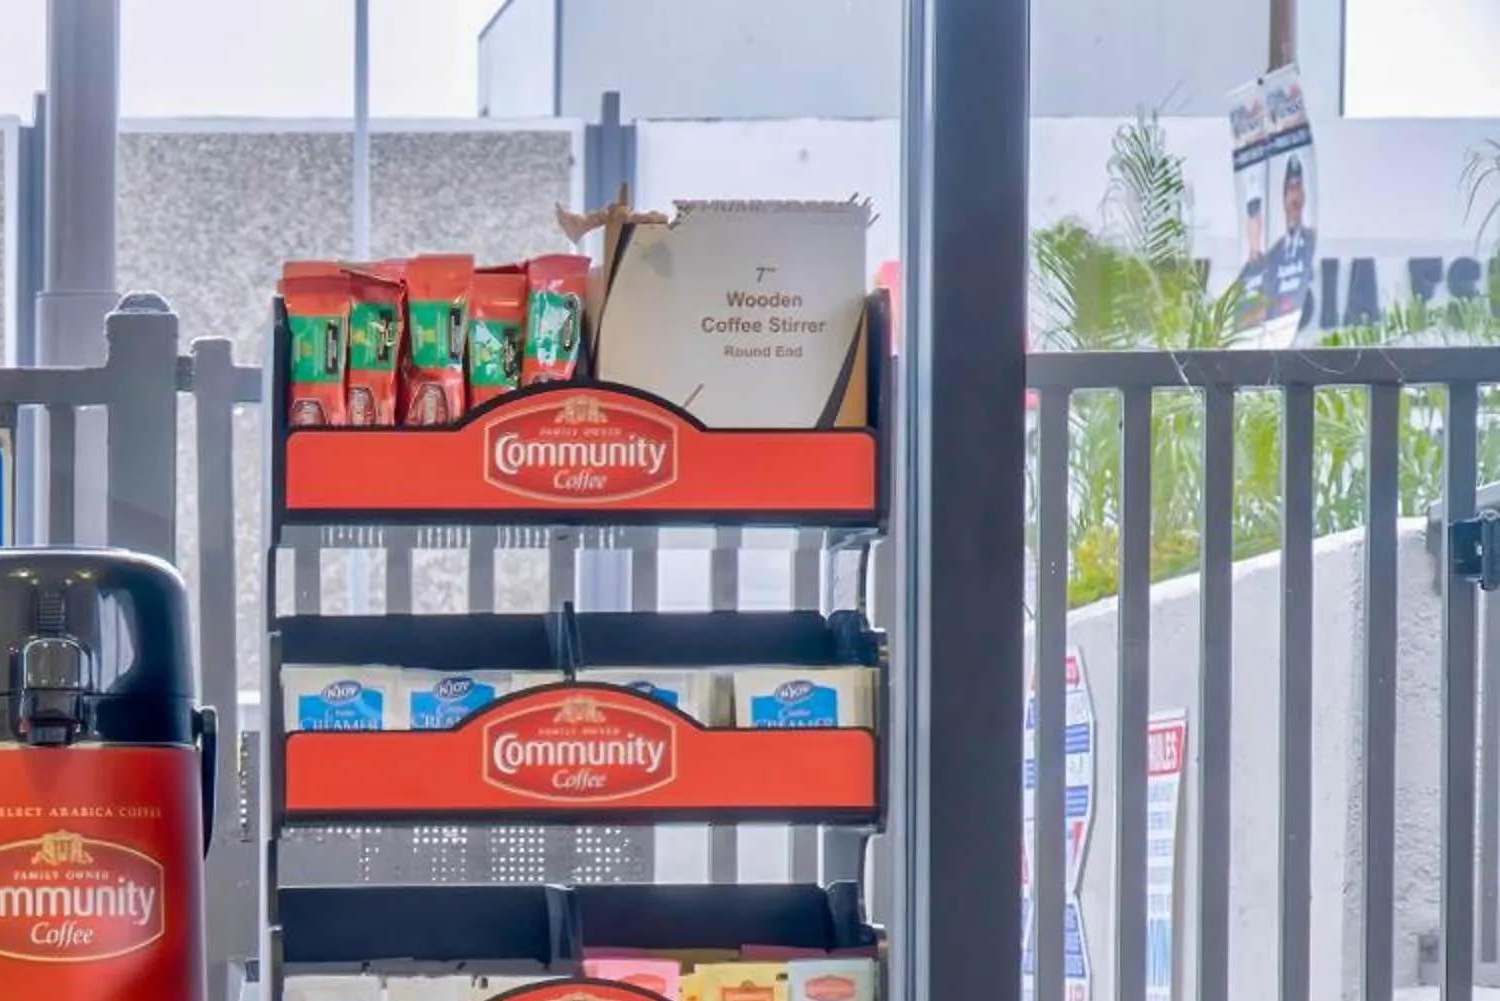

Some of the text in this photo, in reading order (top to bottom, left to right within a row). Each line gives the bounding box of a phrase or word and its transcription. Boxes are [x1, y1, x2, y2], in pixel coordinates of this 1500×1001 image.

[727, 291, 803, 308] Wooden
[701, 317, 827, 333] Coffee Stirrer
[724, 346, 803, 358] Round End
[495, 432, 667, 475] Community
[553, 469, 608, 492] Coffee
[493, 732, 665, 774] Community
[552, 768, 607, 790] Coffee
[49, 807, 113, 818] ARABICA
[13, 871, 109, 881] FAMILY OWNED
[30, 921, 94, 948] Coffee
